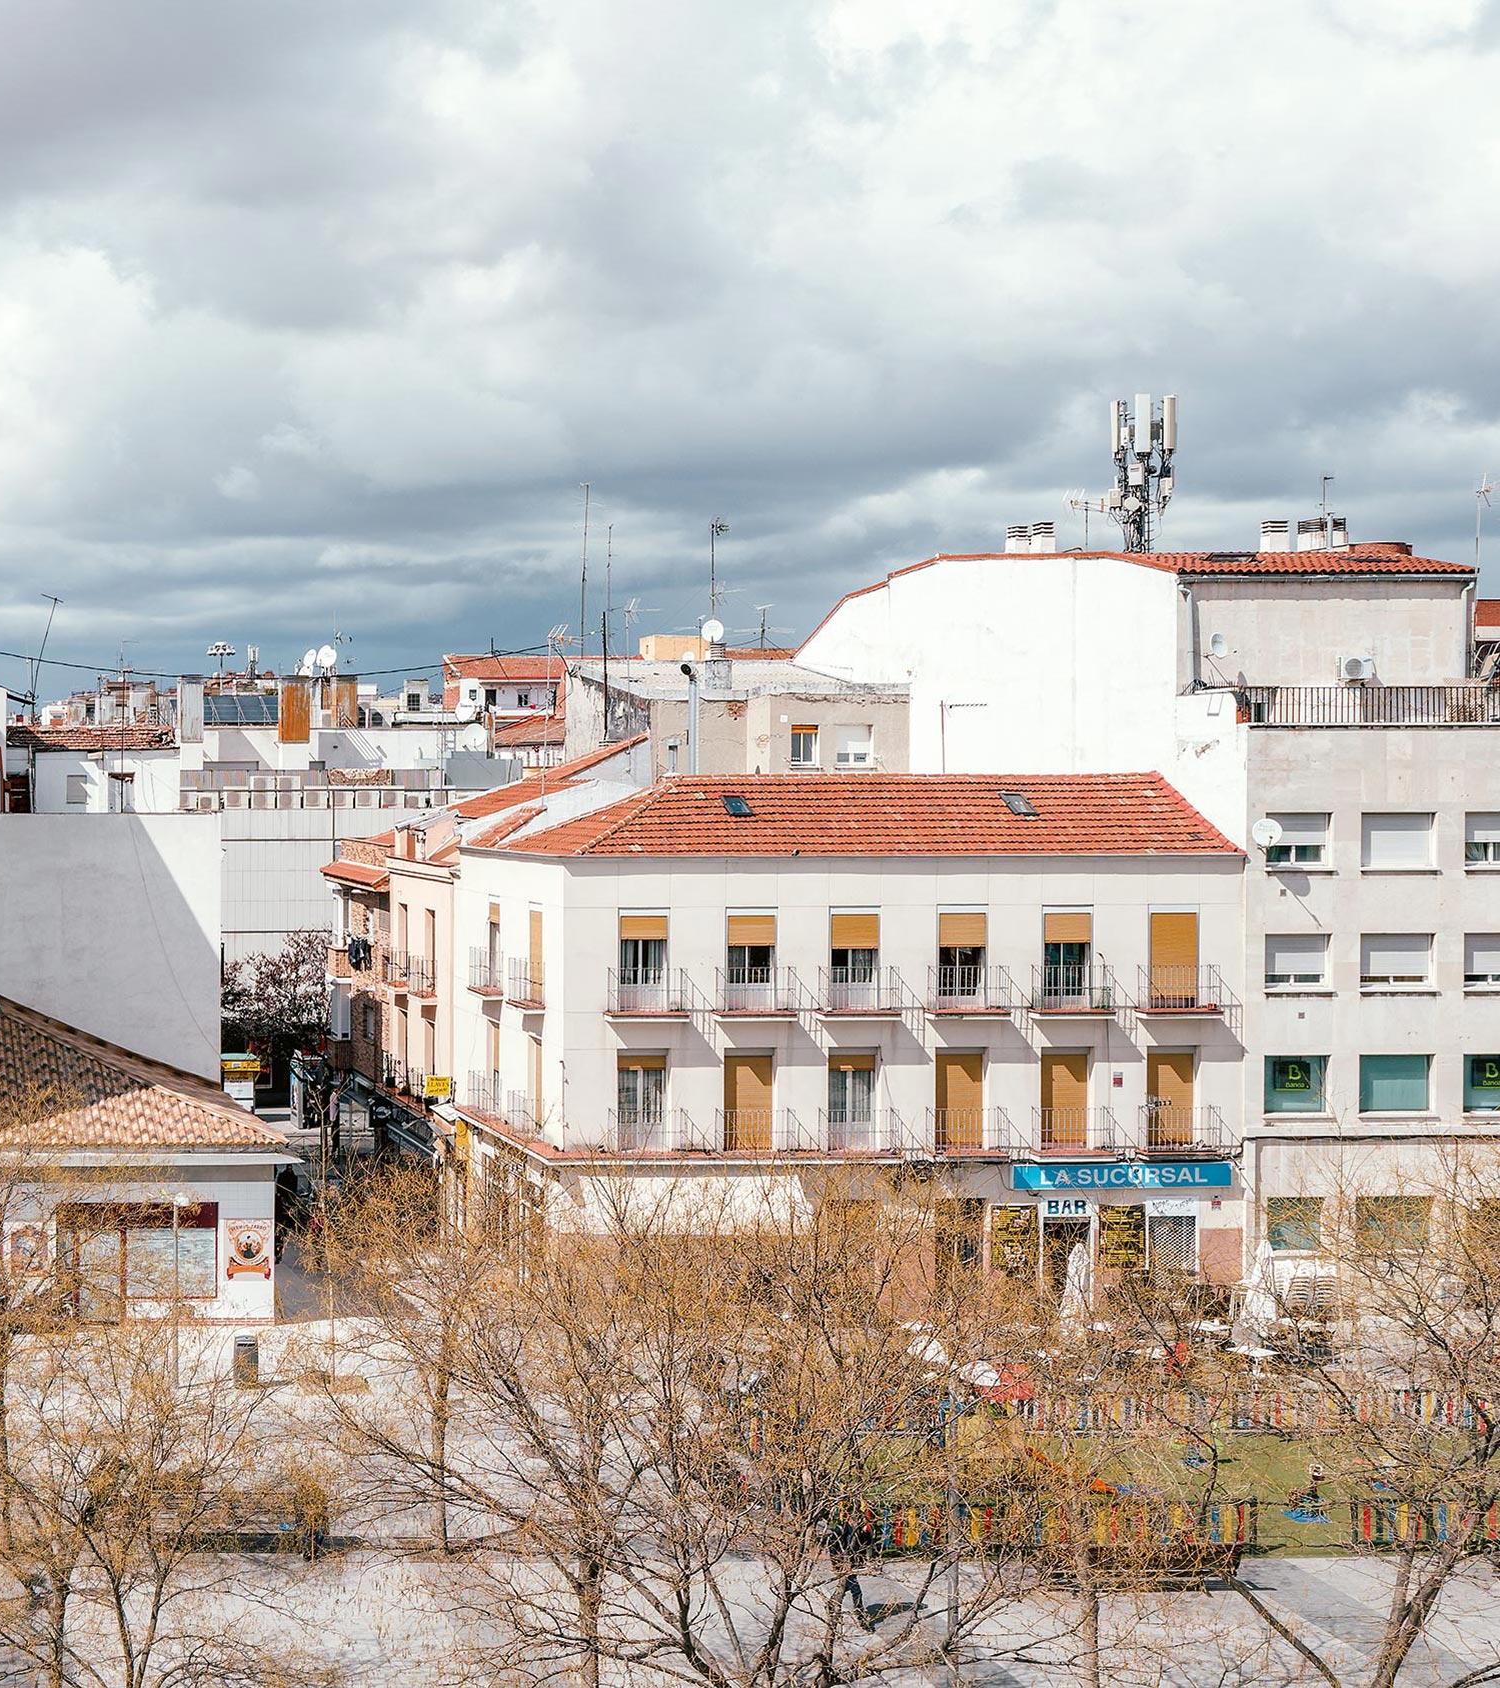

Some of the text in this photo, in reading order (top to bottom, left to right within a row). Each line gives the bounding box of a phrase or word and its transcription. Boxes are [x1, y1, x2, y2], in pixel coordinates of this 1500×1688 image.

[1040, 1167, 1209, 1185] LA SUCURSAL
[1047, 1200, 1087, 1214] BAR
